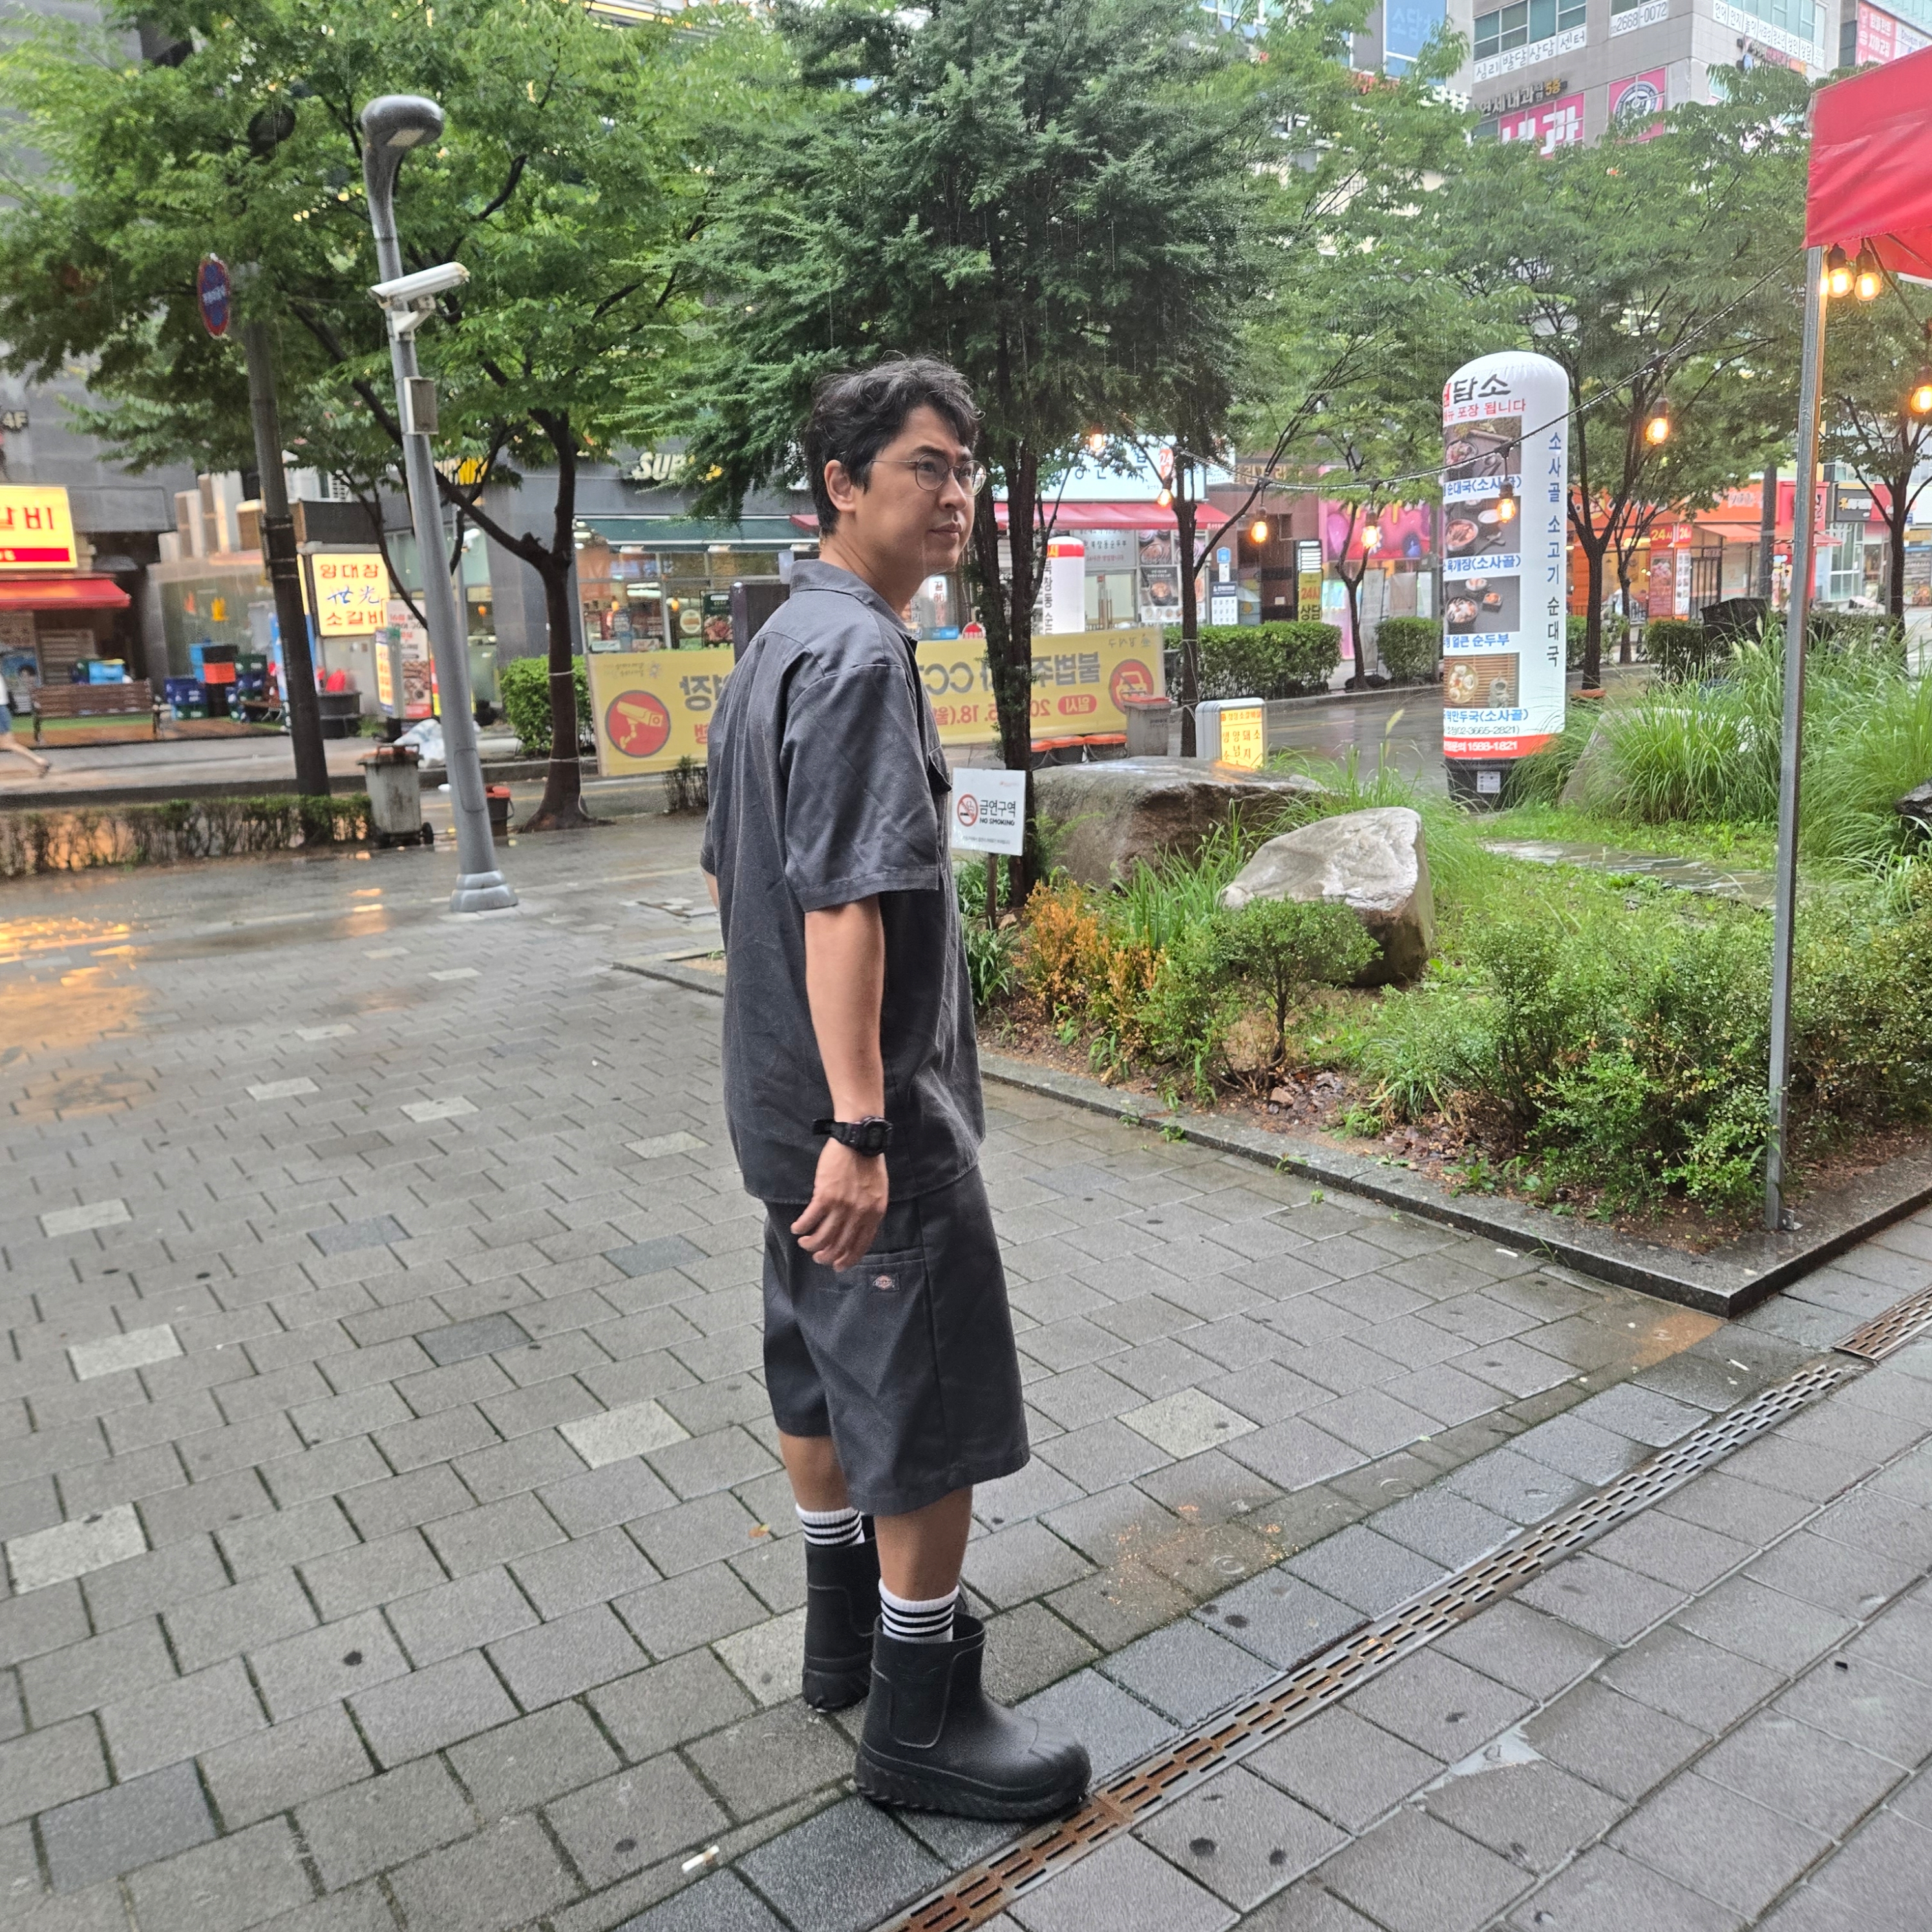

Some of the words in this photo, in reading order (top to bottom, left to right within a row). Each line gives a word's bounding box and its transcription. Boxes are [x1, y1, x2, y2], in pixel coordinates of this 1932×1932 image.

[1616, 3, 1667, 32] 2668-0072
[1476, 63, 1498, 80] 심리
[1503, 49, 1527, 70] 발달
[1529, 39, 1555, 61] 상담
[1560, 30, 1584, 50] 센터
[1545, 78, 1562, 96] 5층
[1453, 374, 1511, 405] 담소
[1458, 403, 1479, 419] 포장
[1484, 398, 1526, 416] 됩니다
[1547, 432, 1562, 502] 소사골
[1547, 515, 1561, 585] 소고기
[1300, 604, 1321, 621] 상담
[1472, 633, 1510, 648] 순두부
[1546, 597, 1560, 668] 순대국
[1467, 741, 1518, 752] 1588-1821
[979, 800, 1016, 818] 금연구역
[989, 818, 1015, 827] SMOKING
